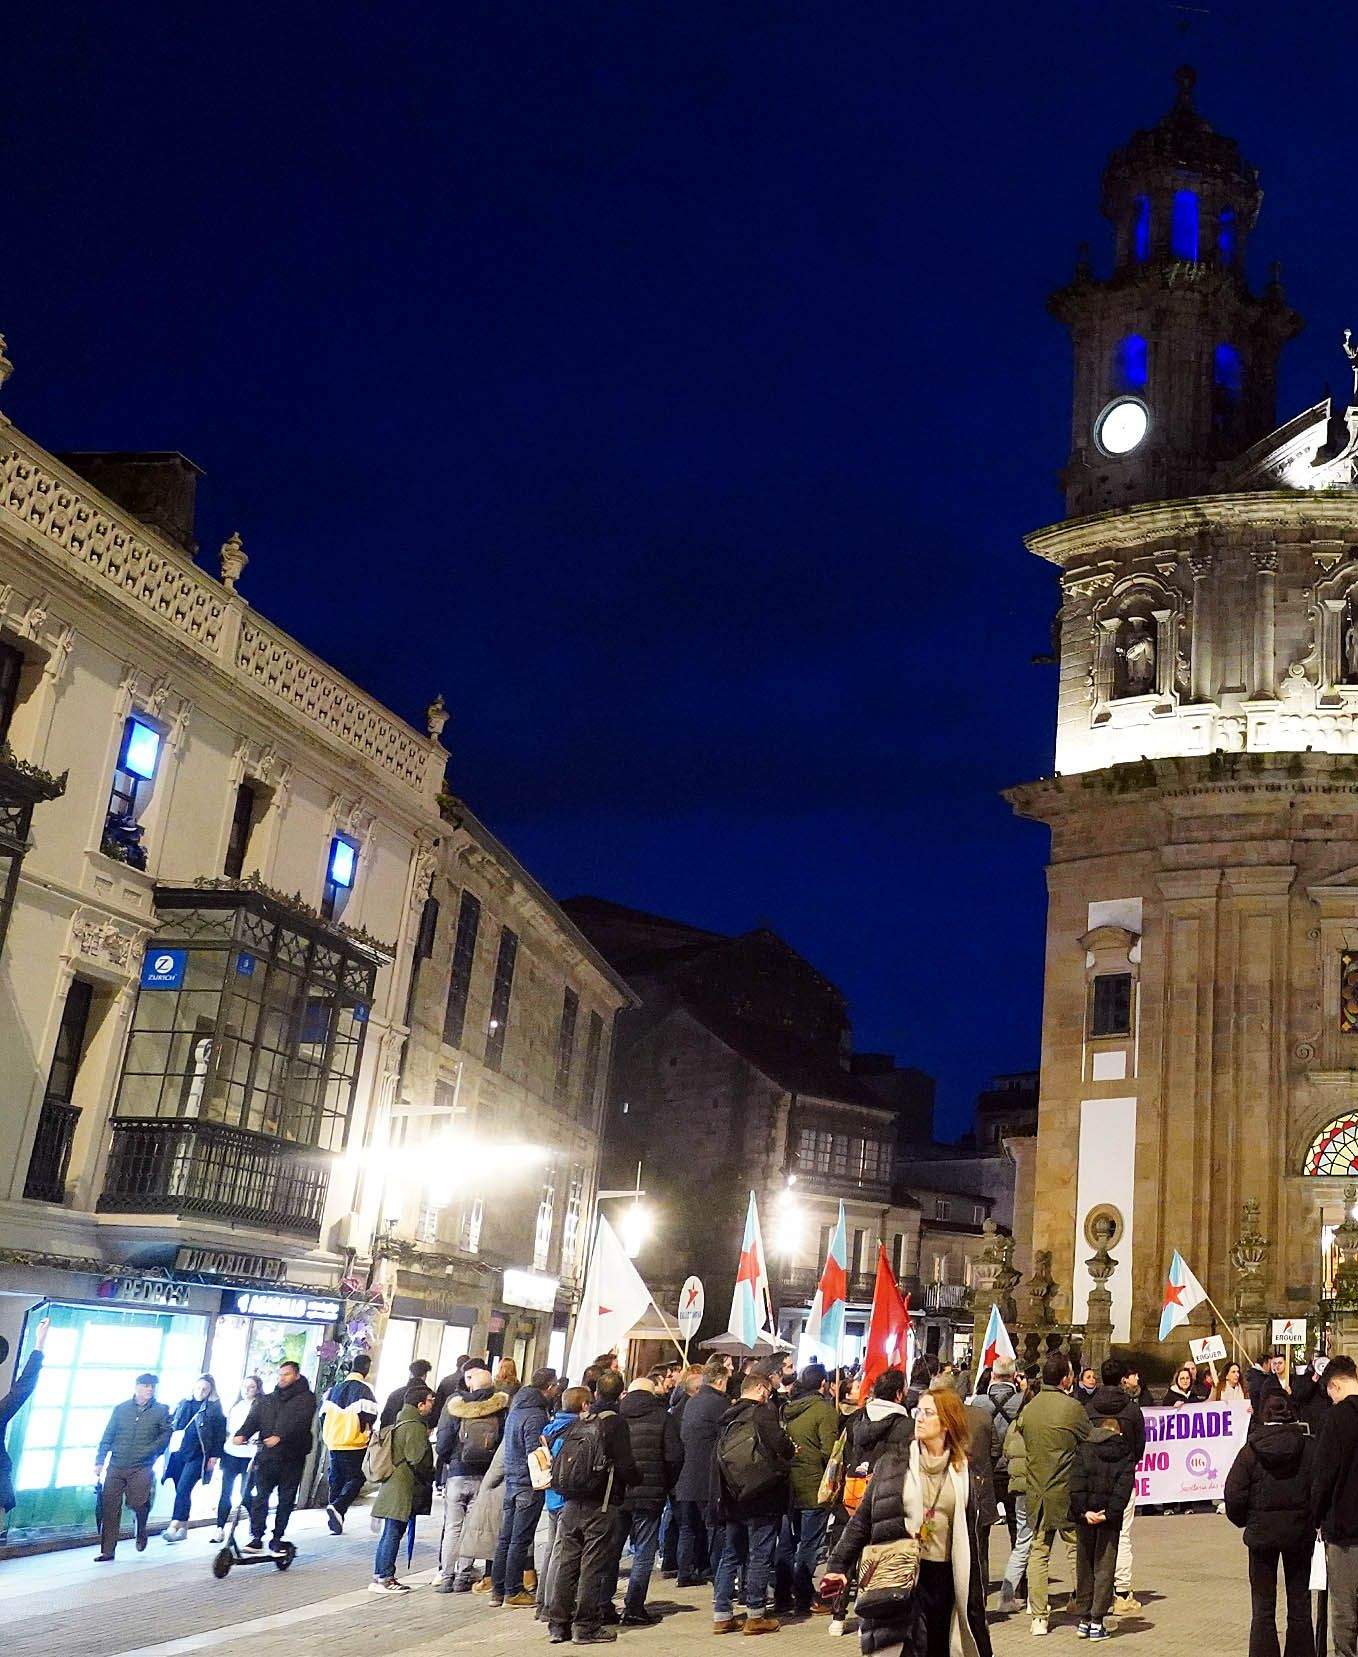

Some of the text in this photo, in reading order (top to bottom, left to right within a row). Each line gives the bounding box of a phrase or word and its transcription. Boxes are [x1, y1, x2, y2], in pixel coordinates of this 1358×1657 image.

[123, 1280, 191, 1306] PEDROSA
[1196, 1350, 1222, 1361] ERGUER
[1144, 1410, 1233, 1442] RIEDADE
